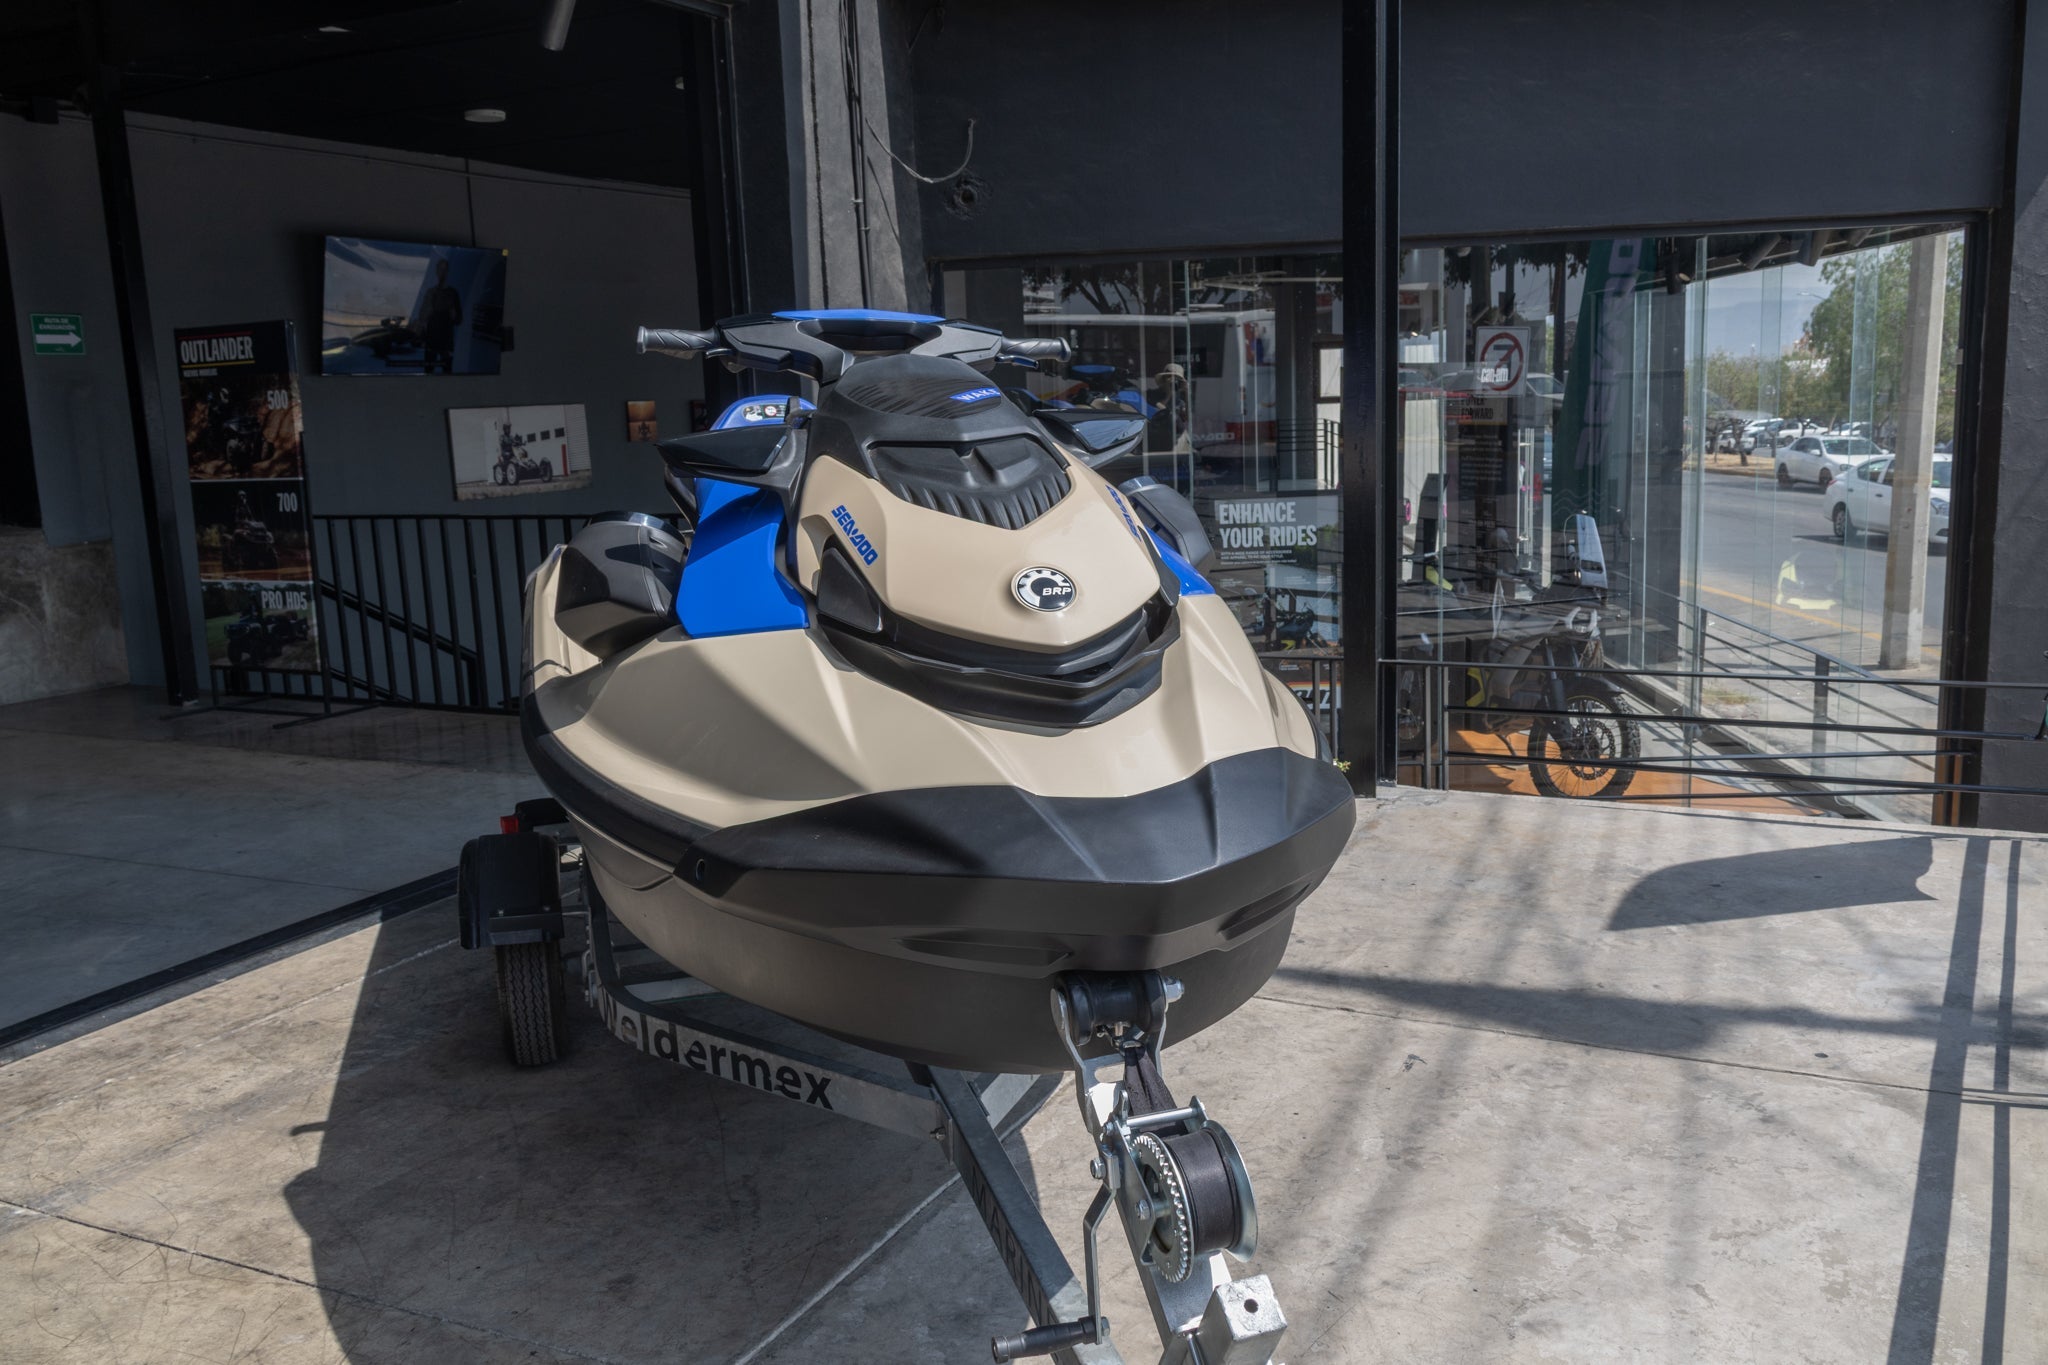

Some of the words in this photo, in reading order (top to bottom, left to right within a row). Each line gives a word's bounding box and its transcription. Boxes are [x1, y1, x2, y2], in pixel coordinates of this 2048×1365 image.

[180, 335, 254, 364] OUTLANDER
[267, 389, 288, 410] 500
[956, 389, 1001, 401] WAKE
[277, 492, 297, 512] 700
[1219, 502, 1296, 524] ENHANCE
[1219, 527, 1264, 548] YOUR
[1269, 525, 1318, 547] RIDES
[261, 590, 283, 610] PRO
[285, 591, 308, 610] HD5
[1042, 587, 1072, 596] BRP
[601, 986, 834, 1111] Weldermex
